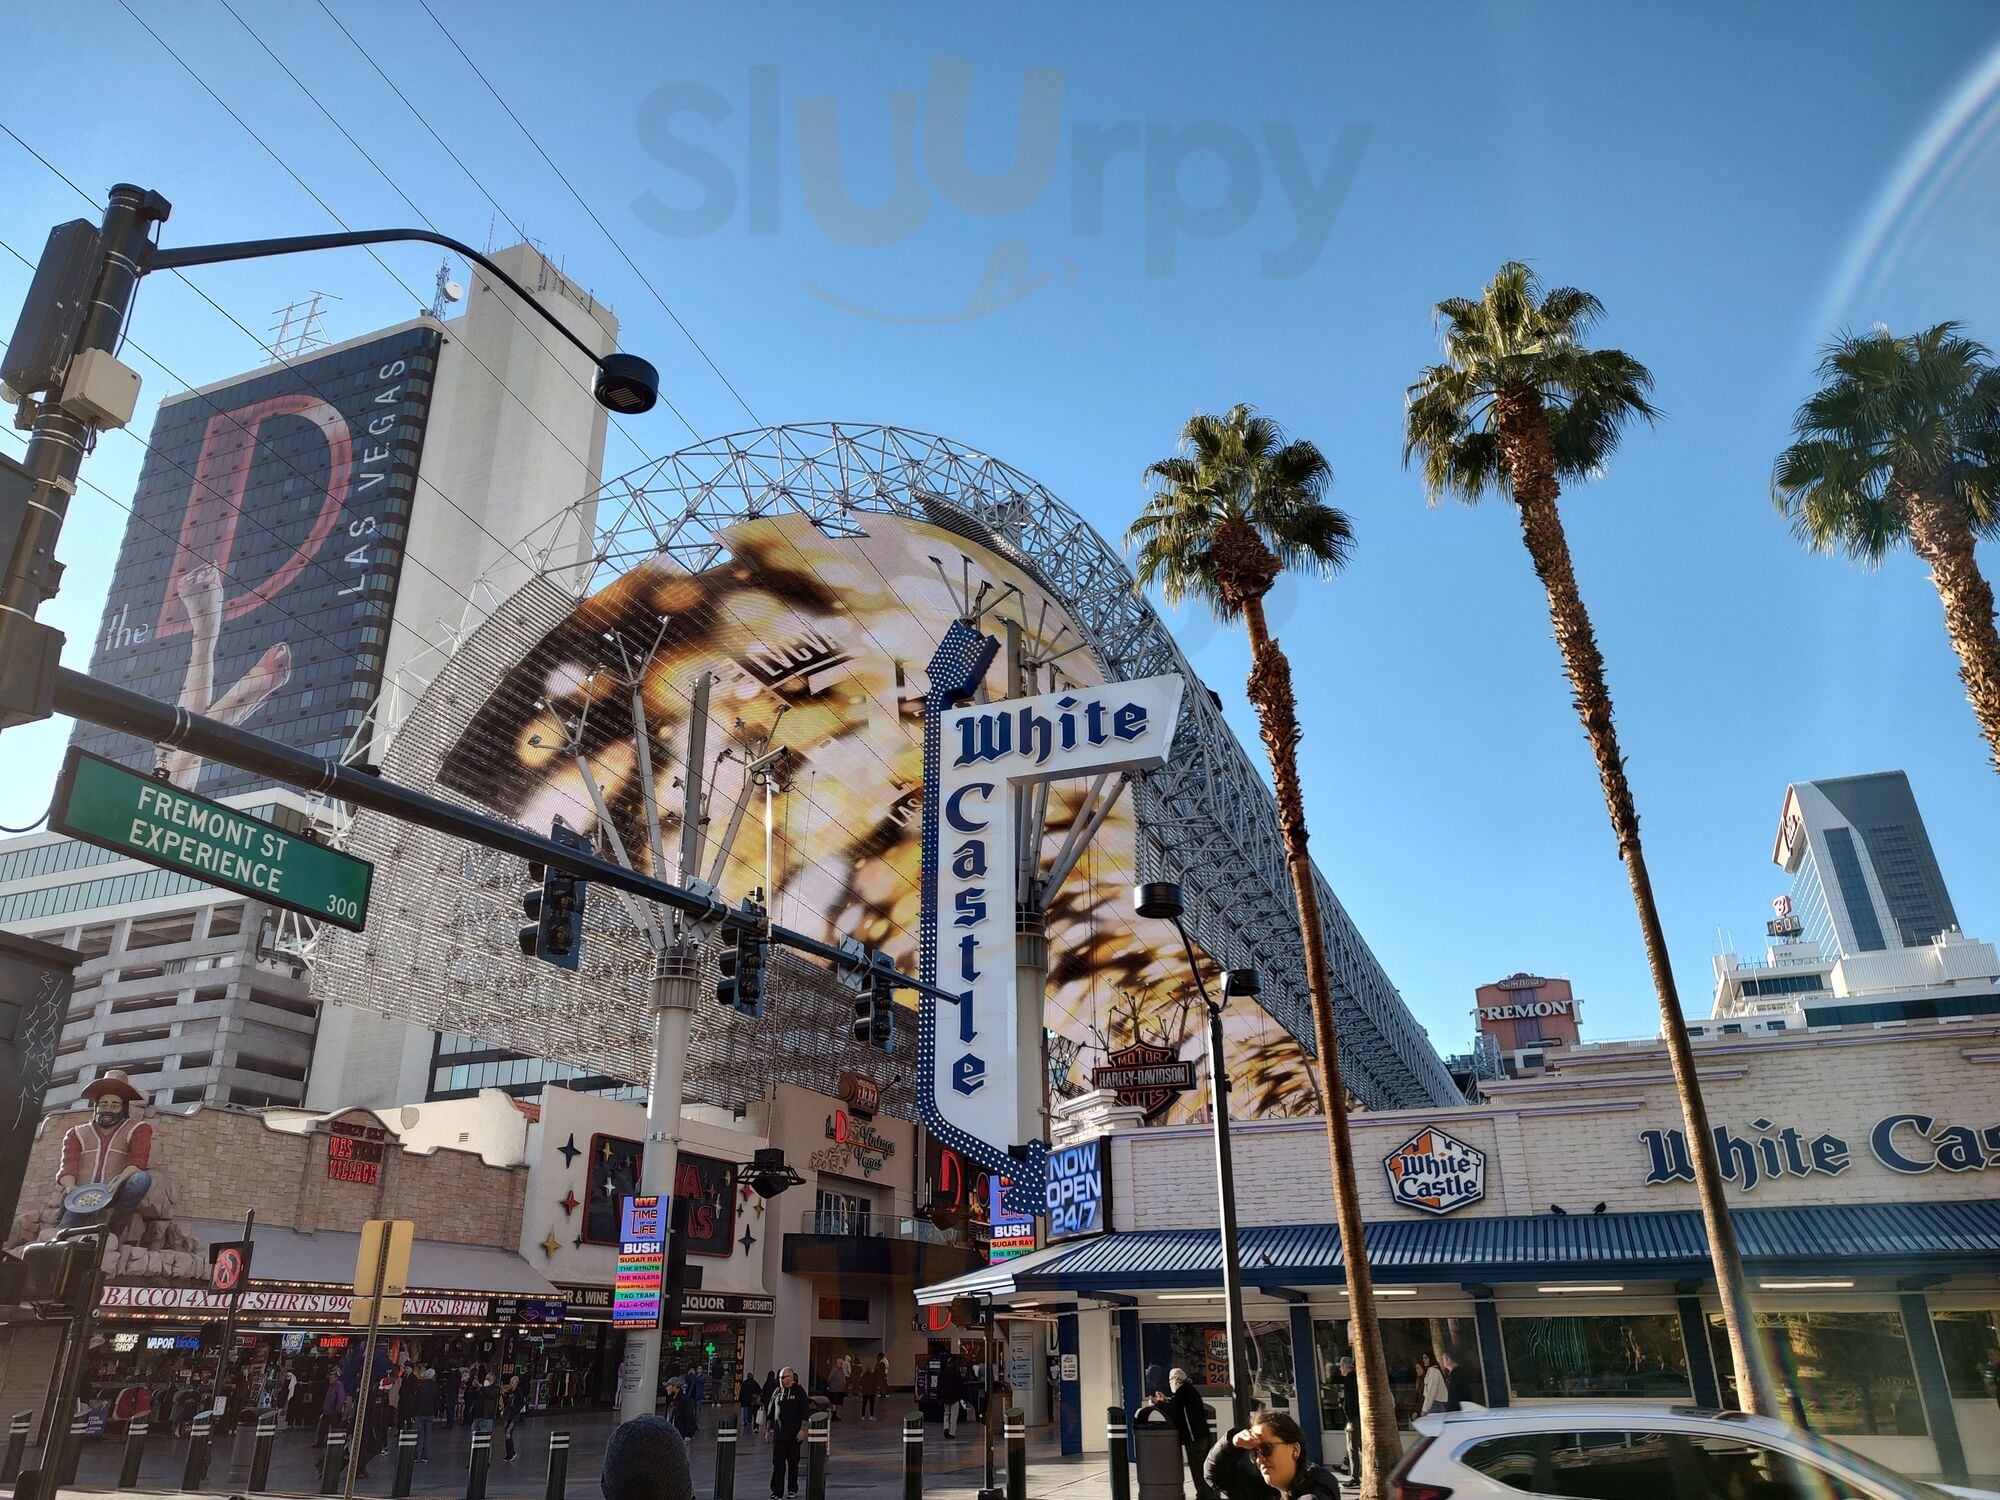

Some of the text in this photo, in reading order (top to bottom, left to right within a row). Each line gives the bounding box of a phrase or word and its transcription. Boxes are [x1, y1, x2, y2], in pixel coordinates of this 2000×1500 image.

[337, 359, 406, 596] LAS VEGAS
[104, 603, 149, 651] the
[953, 696, 1149, 768] White
[137, 785, 288, 861] FREMONT ST
[128, 818, 283, 894] EXPERIENCE
[326, 894, 357, 920] 300
[945, 781, 998, 1097] Castle
[1469, 999, 1584, 1033] FREMONT
[1118, 1048, 1163, 1067] MOTOR
[1098, 1067, 1186, 1089] HARLEY-DAVIDSON
[1049, 1143, 1097, 1181] NOW
[1400, 1151, 1471, 1179] White
[1638, 1115, 1852, 1193] White
[329, 1160, 378, 1184] VILLAGE
[1046, 1170, 1102, 1208] OPEN
[1398, 1175, 1477, 1198] Castle
[634, 1197, 657, 1207] NYE
[1052, 1200, 1096, 1234] 24/7
[994, 1224, 1031, 1237] BUSH
[623, 1242, 660, 1254] BUSH
[991, 1240, 1017, 1248] SUGAR
[101, 1287, 177, 1306] BACCO
[240, 1293, 319, 1312] T-SHIRTS
[448, 1301, 489, 1316] BEER
[576, 1290, 584, 1304] &
[585, 1291, 609, 1304] WINE
[742, 1300, 773, 1311] SWEATSHIRTS
[114, 1343, 135, 1352] SHOP
[115, 1333, 139, 1344] SMOKE
[147, 1337, 175, 1349] VAPOR
